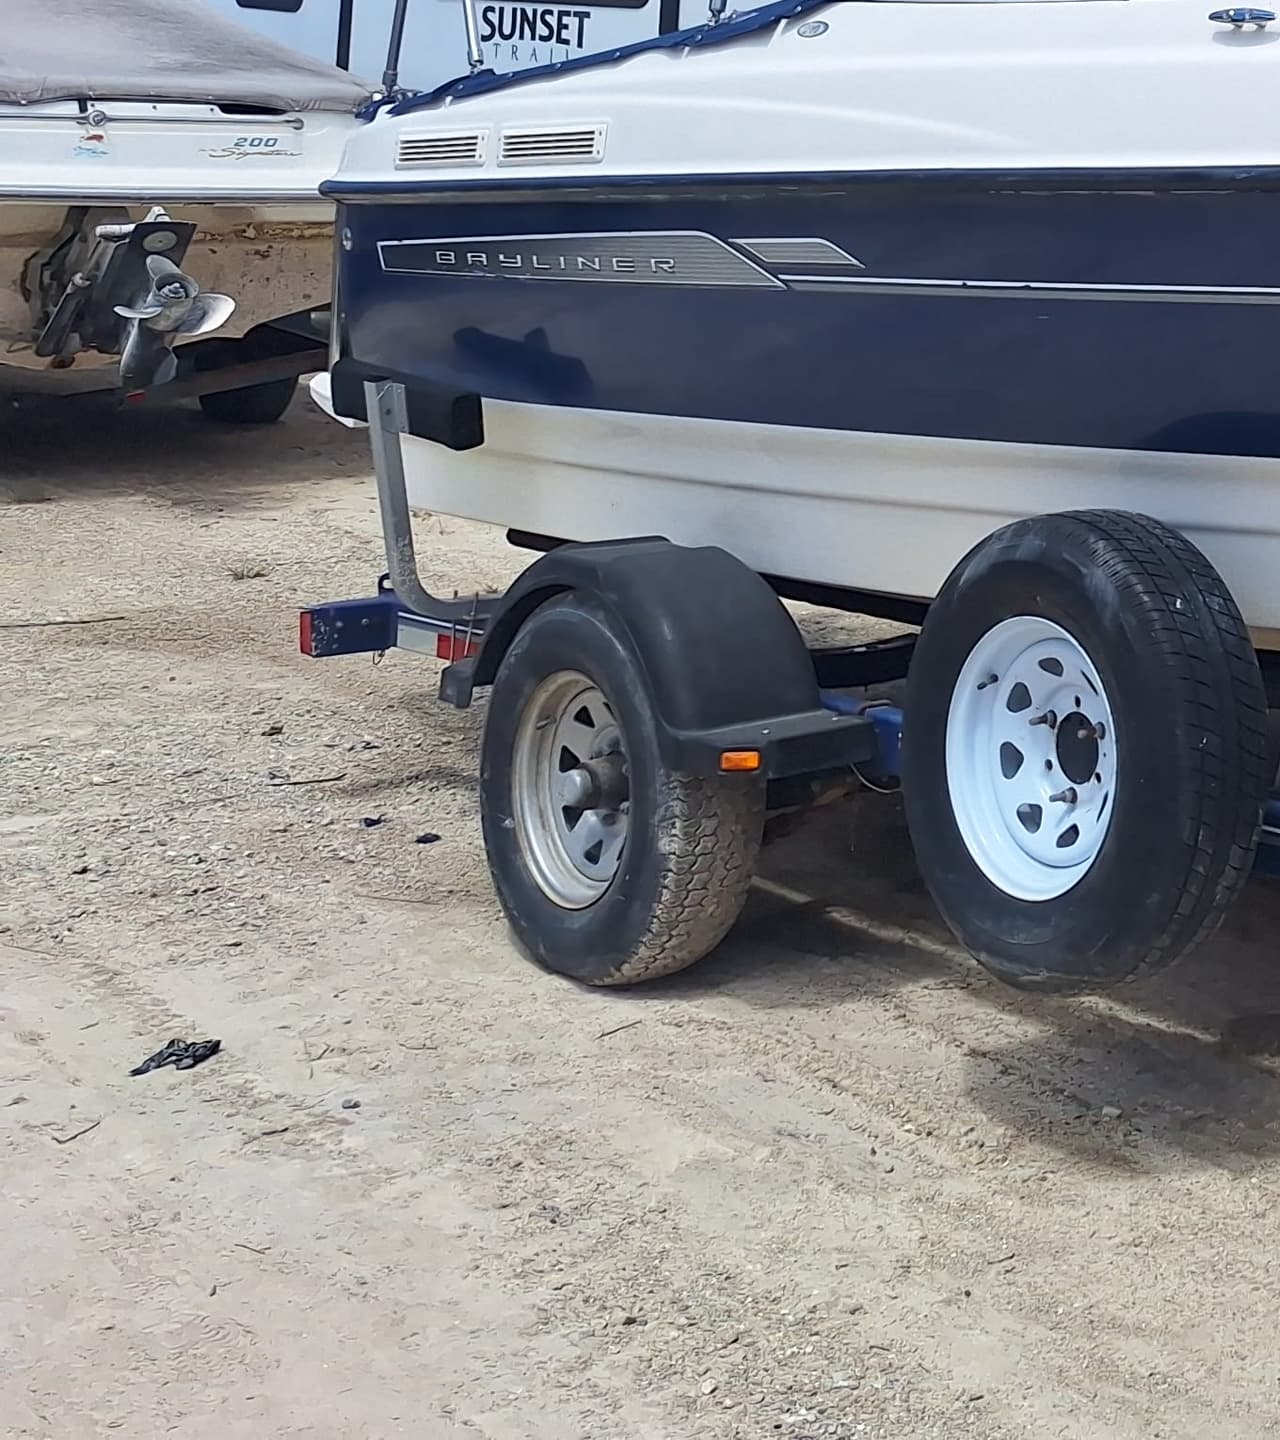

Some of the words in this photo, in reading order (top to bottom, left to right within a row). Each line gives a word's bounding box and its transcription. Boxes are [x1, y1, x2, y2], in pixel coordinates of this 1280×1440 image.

[480, 5, 591, 49] SUNSET
[233, 137, 279, 148] 200
[435, 250, 677, 273] BAYLINER
